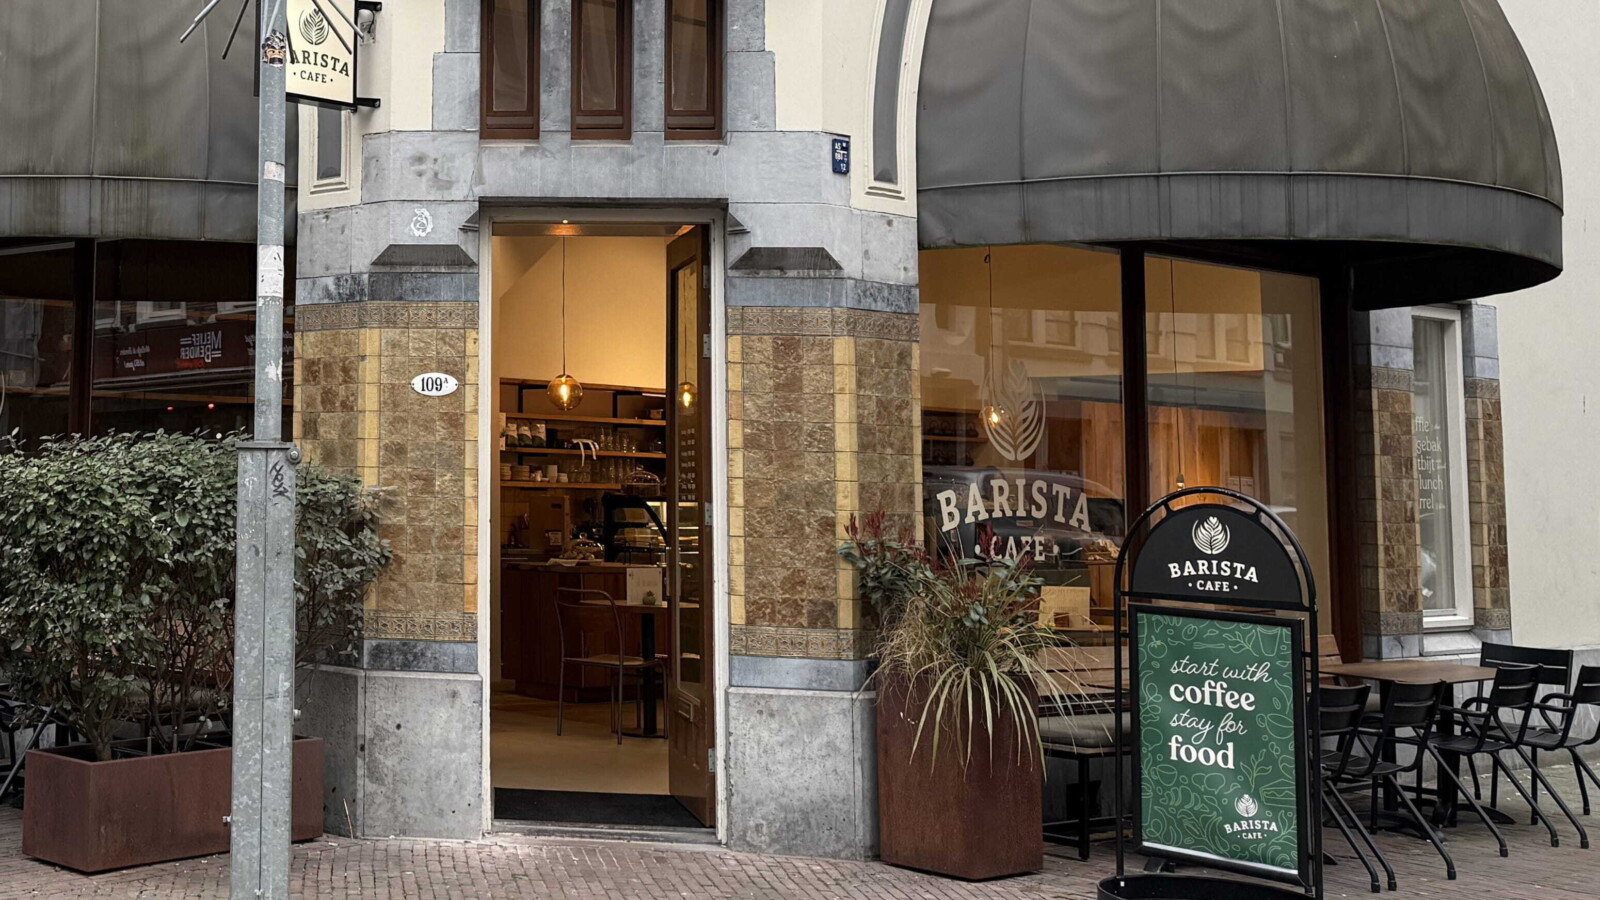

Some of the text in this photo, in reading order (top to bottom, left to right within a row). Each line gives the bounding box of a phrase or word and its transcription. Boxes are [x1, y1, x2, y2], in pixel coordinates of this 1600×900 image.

[289, 49, 350, 77] ARISTA
[300, 70, 327, 83] CAFE
[1417, 455, 1435, 473] tbijt
[1419, 474, 1443, 490] lunch
[936, 478, 1091, 533] BARISTA
[1167, 560, 1258, 583] BARISTA
[1196, 580, 1230, 592] CAFE
[1170, 655, 1272, 683] start with
[1169, 679, 1256, 711] coffee
[1169, 708, 1248, 746] stay for
[1168, 734, 1235, 770] food
[1223, 819, 1279, 834] BARISTA
